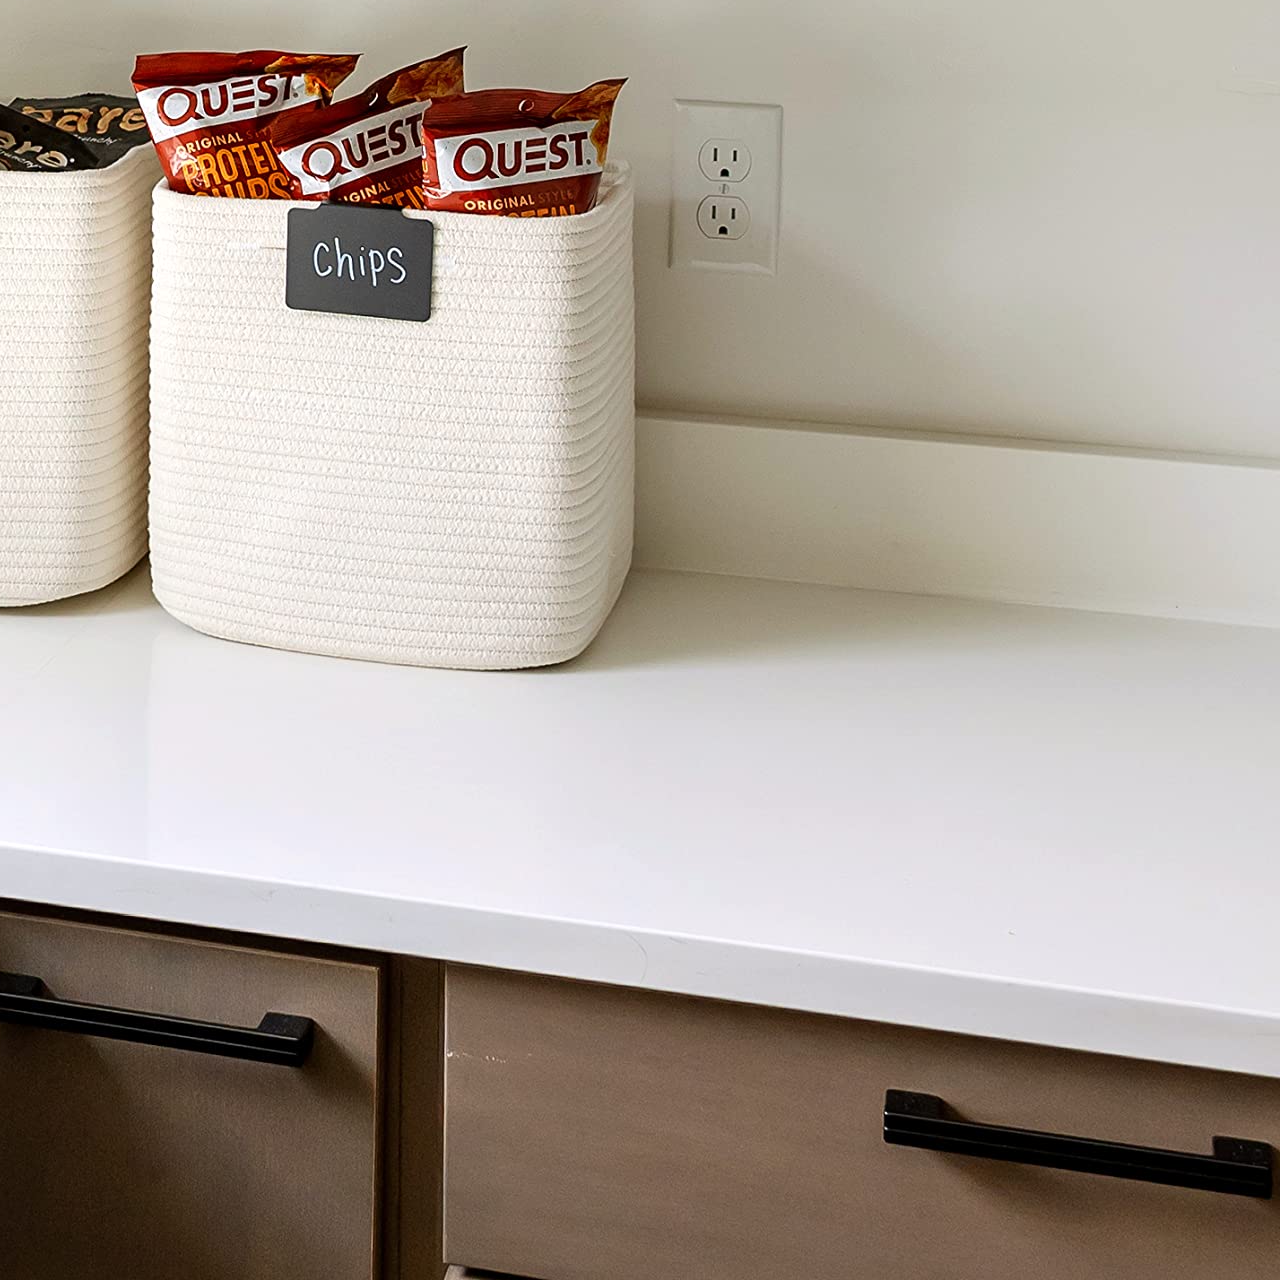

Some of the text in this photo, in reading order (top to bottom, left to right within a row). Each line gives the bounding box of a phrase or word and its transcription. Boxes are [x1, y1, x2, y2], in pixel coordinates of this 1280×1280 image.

[157, 73, 294, 127] QUEST
[175, 132, 244, 155] ORIGINAL
[182, 139, 279, 192] PROTEI
[301, 112, 423, 182] QUEST
[453, 131, 588, 183] QUEST
[464, 194, 535, 211] ORIGINAL
[537, 190, 574, 203] STYLE
[312, 237, 408, 286] Chips
